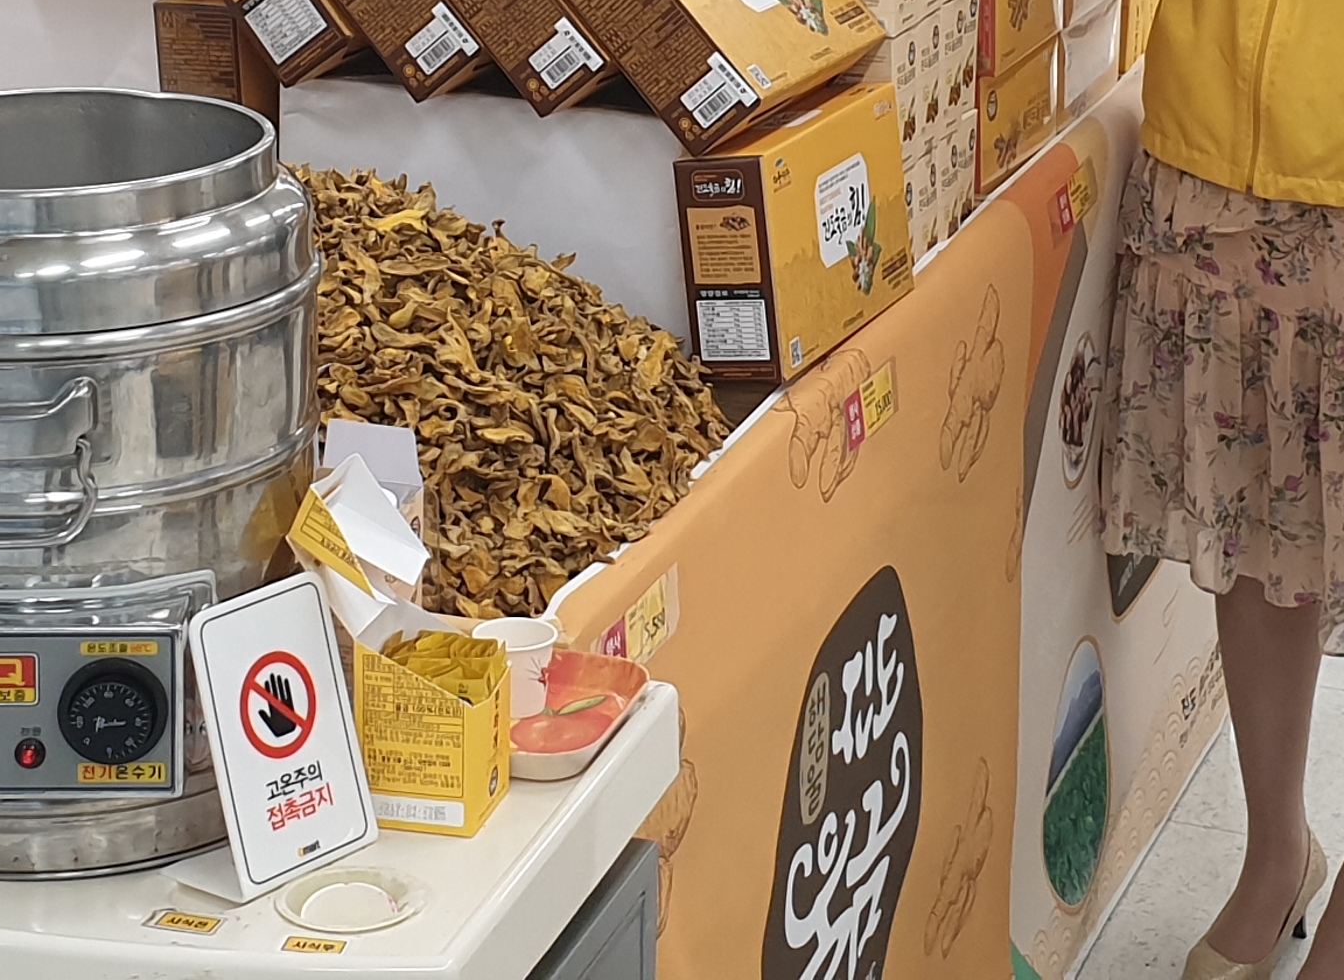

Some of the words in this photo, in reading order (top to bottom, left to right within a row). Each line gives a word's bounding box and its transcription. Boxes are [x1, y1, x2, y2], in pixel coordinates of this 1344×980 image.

[81, 764, 162, 781] 전기온수기
[265, 760, 324, 802] 고온주의
[266, 783, 334, 832] 접촉금지
